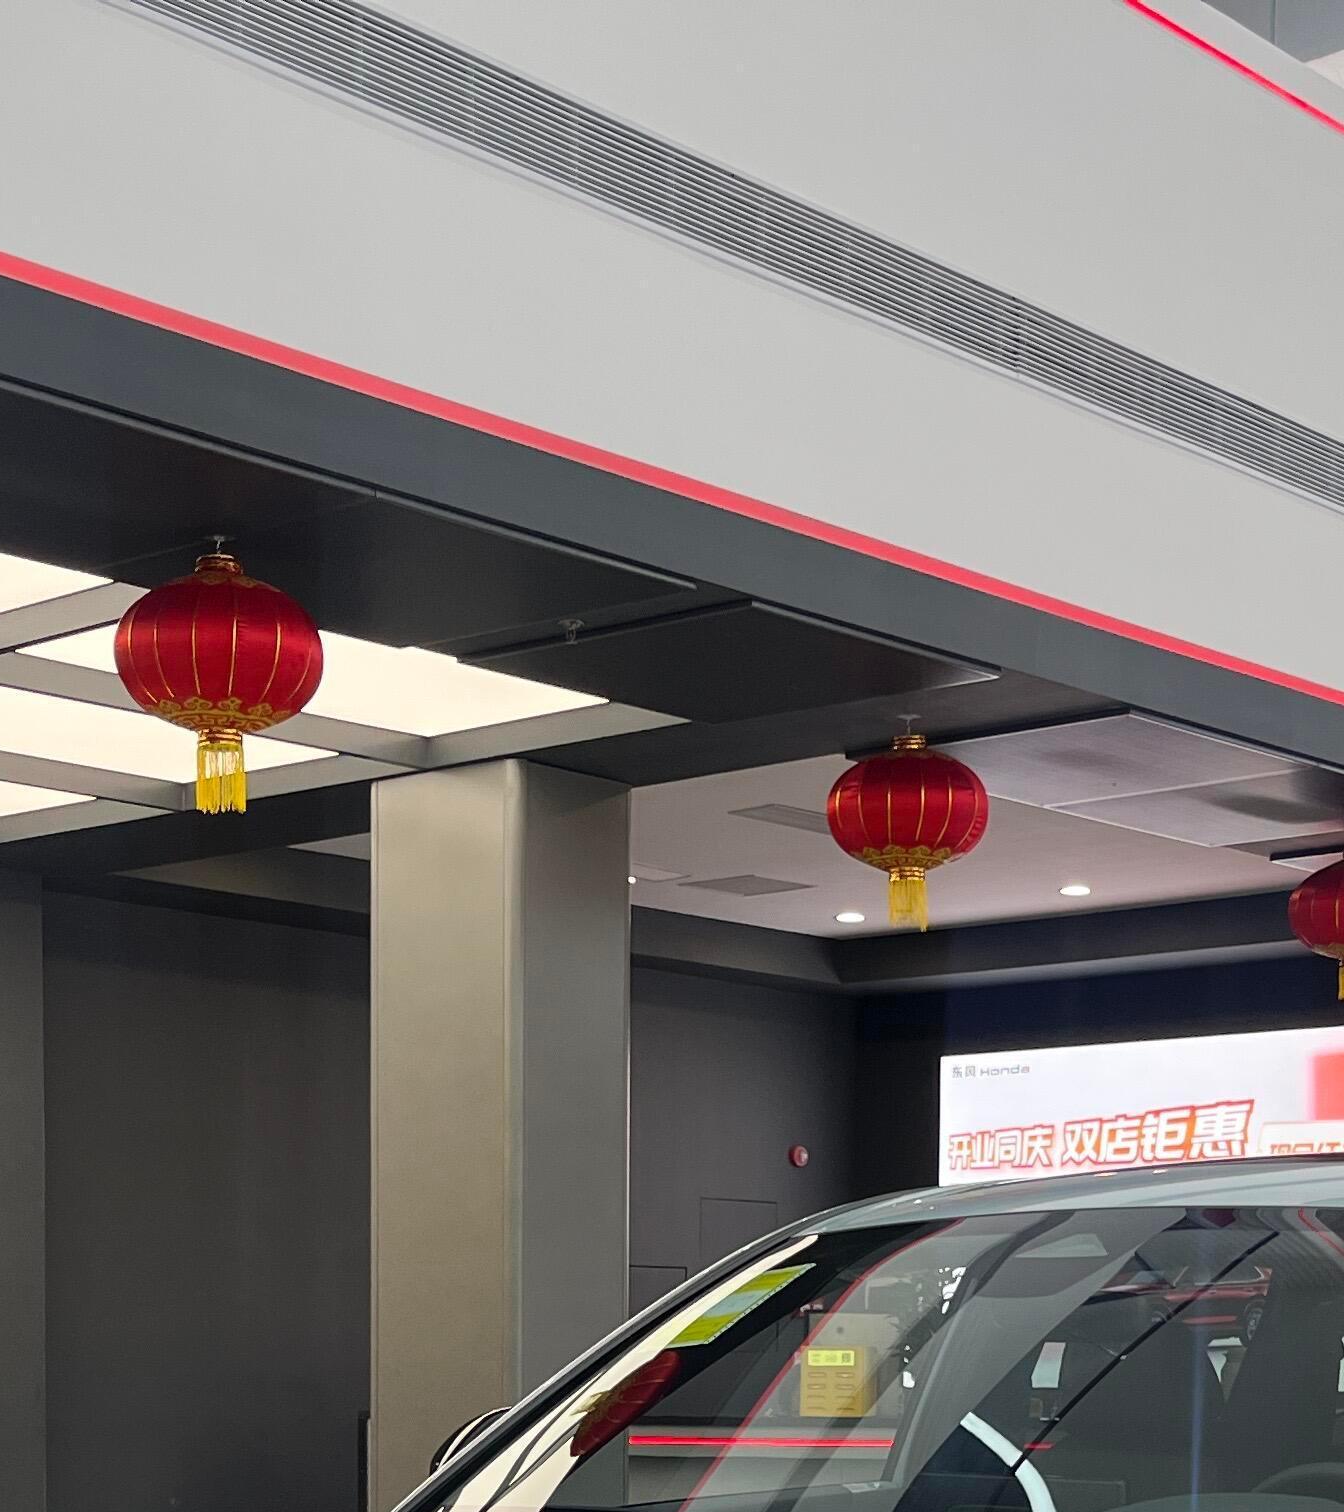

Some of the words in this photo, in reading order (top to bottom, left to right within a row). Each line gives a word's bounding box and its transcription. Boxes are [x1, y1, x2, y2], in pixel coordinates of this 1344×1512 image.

[980, 1065, 1030, 1077] Honda
[948, 1125, 1055, 1170] 开业同庆
[1061, 1099, 1255, 1166] 双店钜惠
